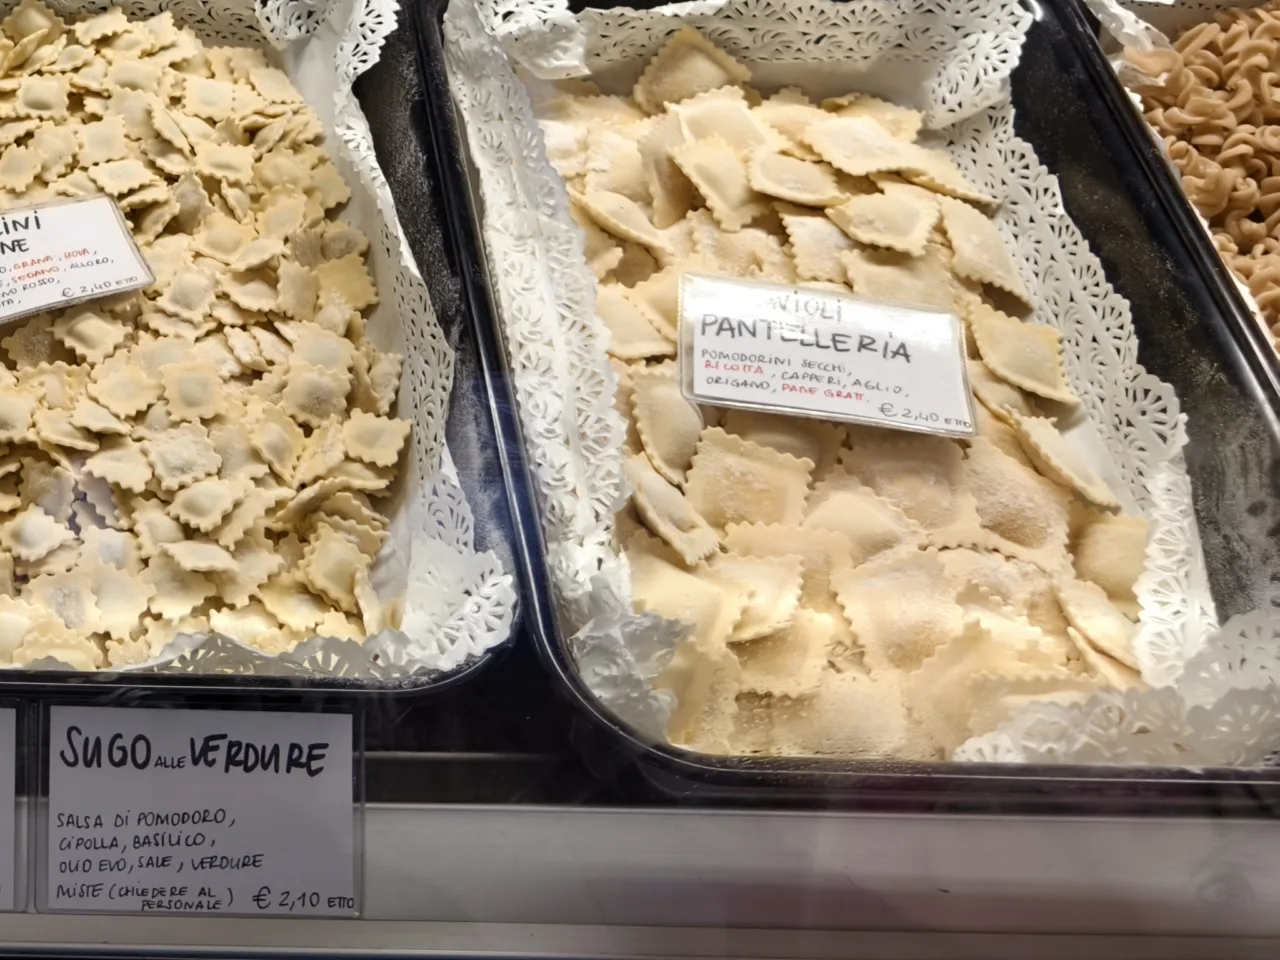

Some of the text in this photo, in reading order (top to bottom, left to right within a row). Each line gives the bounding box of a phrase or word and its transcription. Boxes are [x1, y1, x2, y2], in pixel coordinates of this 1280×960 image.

[701, 313, 911, 364] PANTELLERIA
[701, 348, 792, 368] POMODORINI
[781, 383, 817, 396] PANE
[59, 725, 330, 777] SUGO ALLE VERDURE
[57, 812, 103, 829] SALSA
[114, 810, 131, 828] DI
[59, 859, 92, 874] OLIO
[191, 853, 265, 872] VERDURE
[57, 883, 104, 899] MISTE
[327, 897, 355, 909] ETTO
